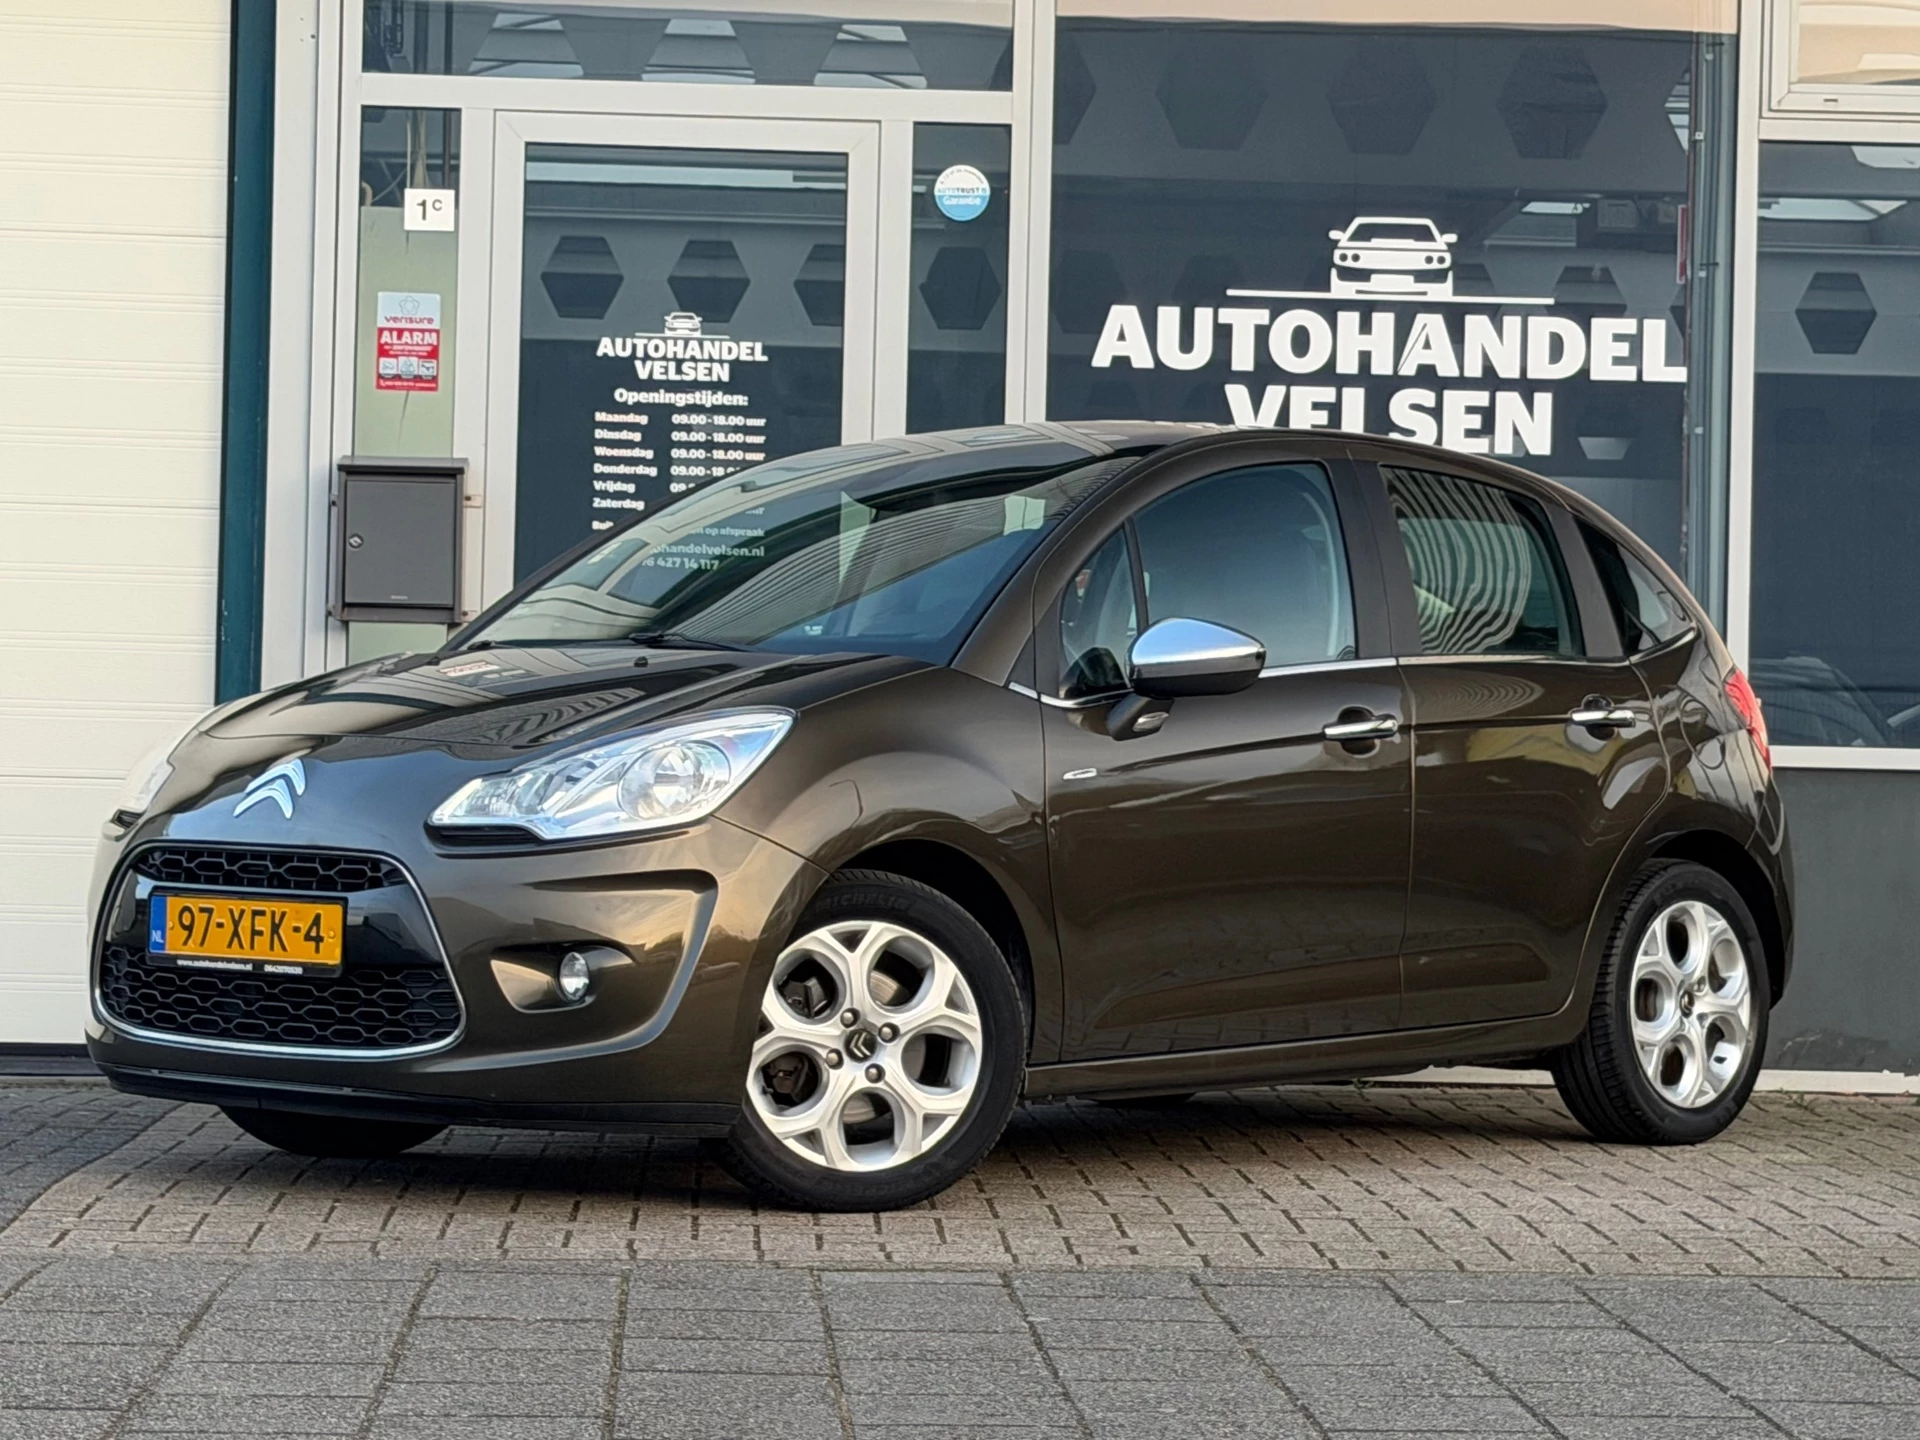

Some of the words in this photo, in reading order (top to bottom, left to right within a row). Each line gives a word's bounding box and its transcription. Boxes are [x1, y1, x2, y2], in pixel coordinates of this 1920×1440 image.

[384, 315, 435, 325] verisure
[380, 330, 438, 346] ALARM
[1091, 304, 1688, 383] AUTOHANDEL
[596, 336, 769, 362] AUTOHANDEL
[634, 360, 730, 382] VELSEN
[614, 388, 749, 407] Openingstijden:
[595, 411, 649, 425] Maandag
[746, 417, 767, 427] uur
[594, 428, 642, 442] Dinsdag
[745, 434, 766, 444] uur
[594, 446, 654, 459] Woensdag
[744, 451, 766, 461] uur
[593, 463, 658, 477] Donderdag
[592, 480, 636, 494] Vrijdag
[592, 497, 645, 511] Zaterdag
[705, 526, 719, 536] op
[720, 526, 765, 537] afspraak
[656, 557, 681, 568] 427
[683, 557, 699, 569] 14
[151, 930, 165, 944] NL
[177, 905, 325, 955] 97-XFK-4
